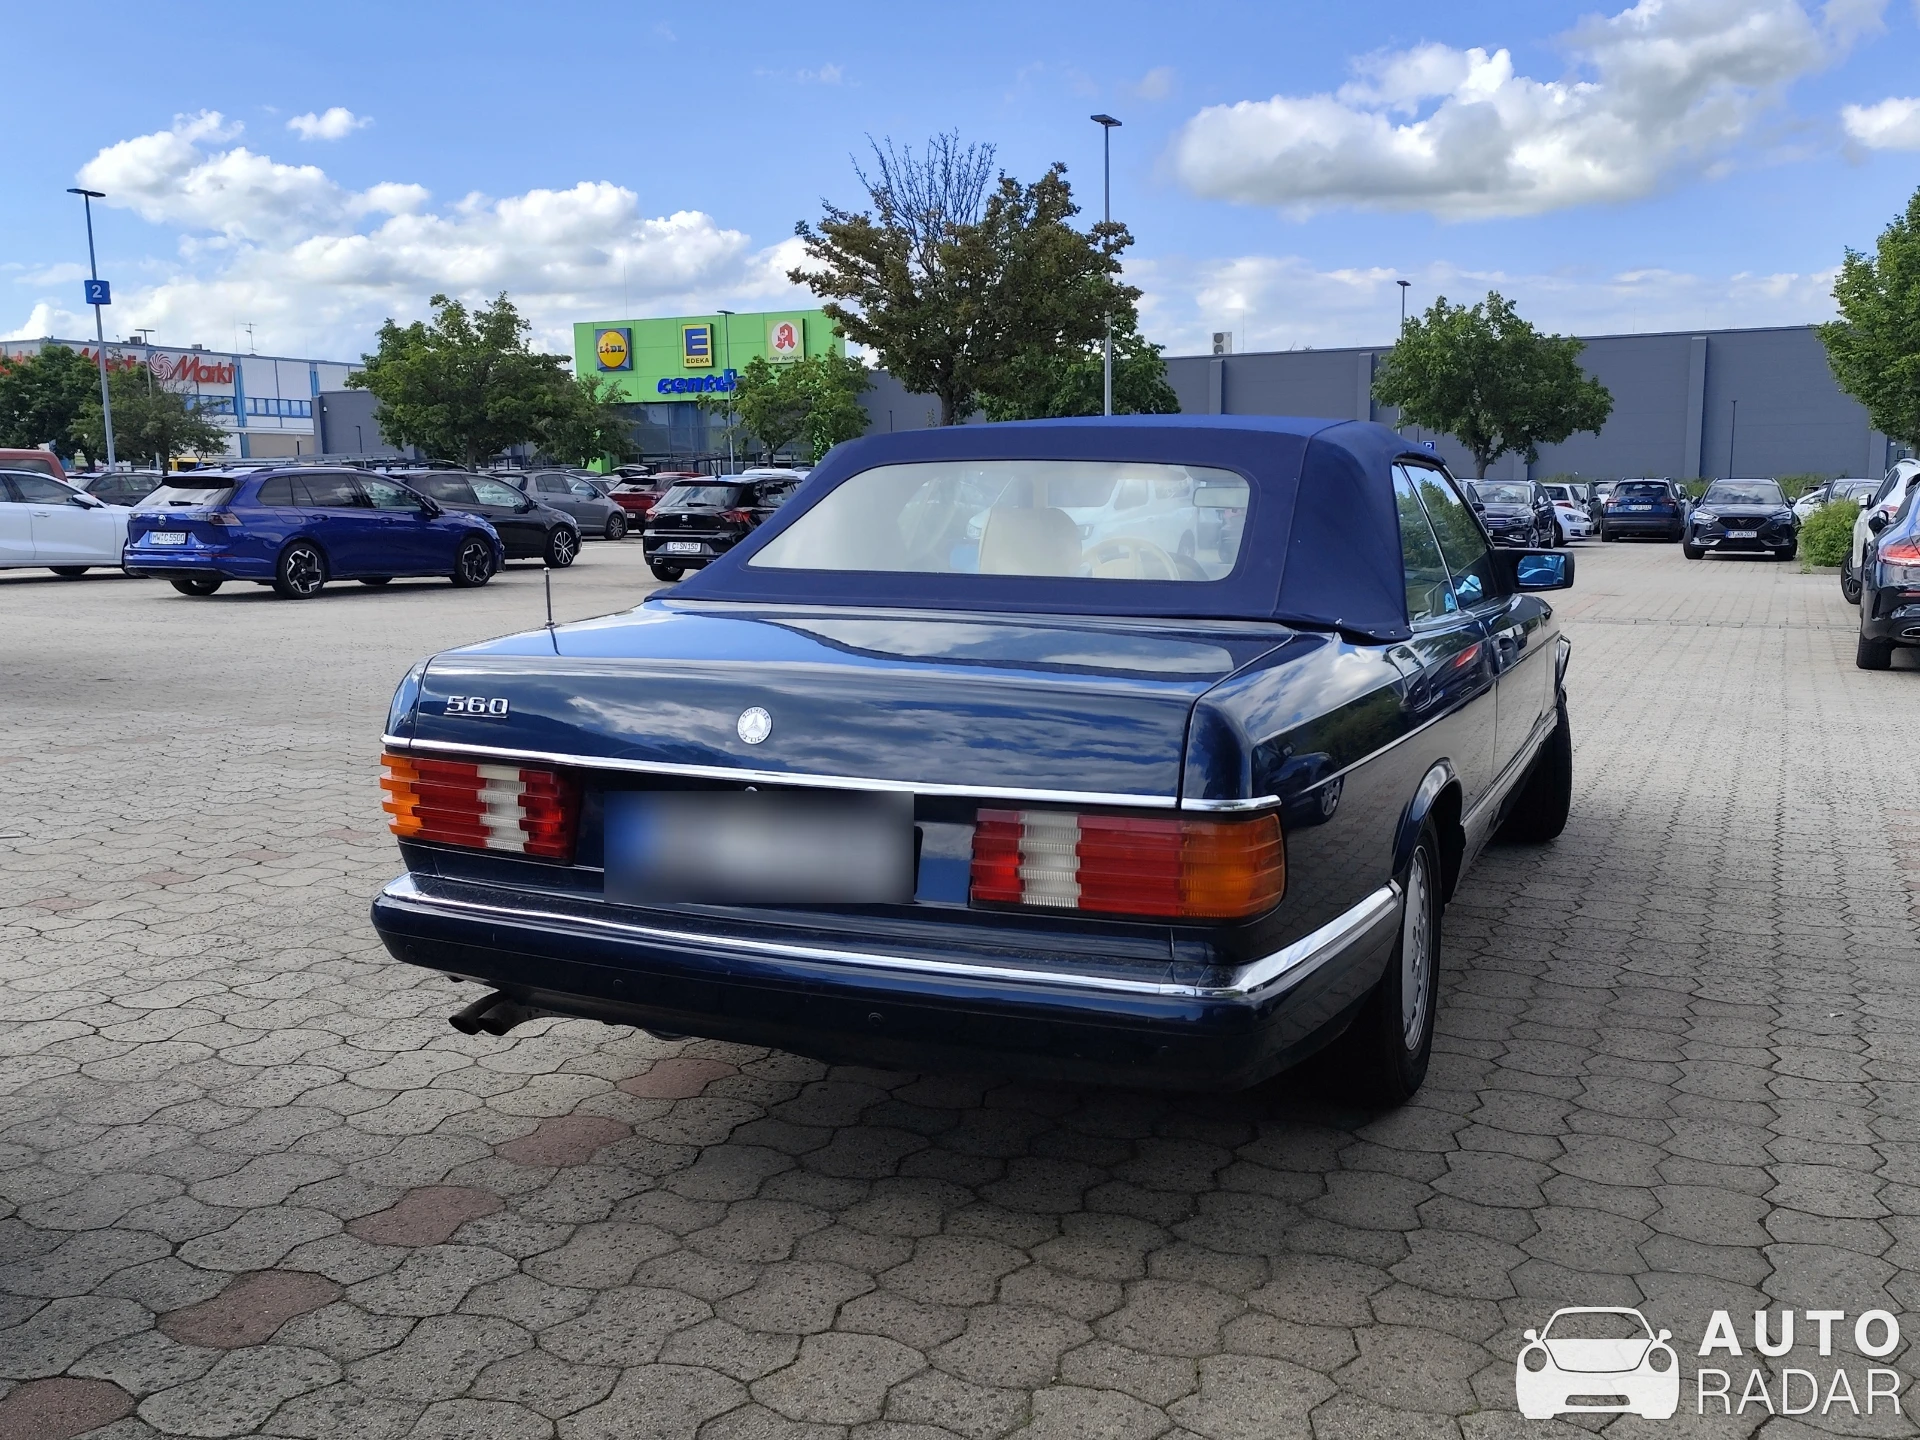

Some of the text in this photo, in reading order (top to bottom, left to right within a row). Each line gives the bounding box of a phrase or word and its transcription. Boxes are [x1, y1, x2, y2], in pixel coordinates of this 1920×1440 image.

[91, 284, 103, 299] 2
[685, 328, 708, 356] E
[171, 355, 236, 384] Markt
[729, 371, 735, 381] 1
[657, 374, 746, 395] cente
[446, 695, 509, 715] 560
